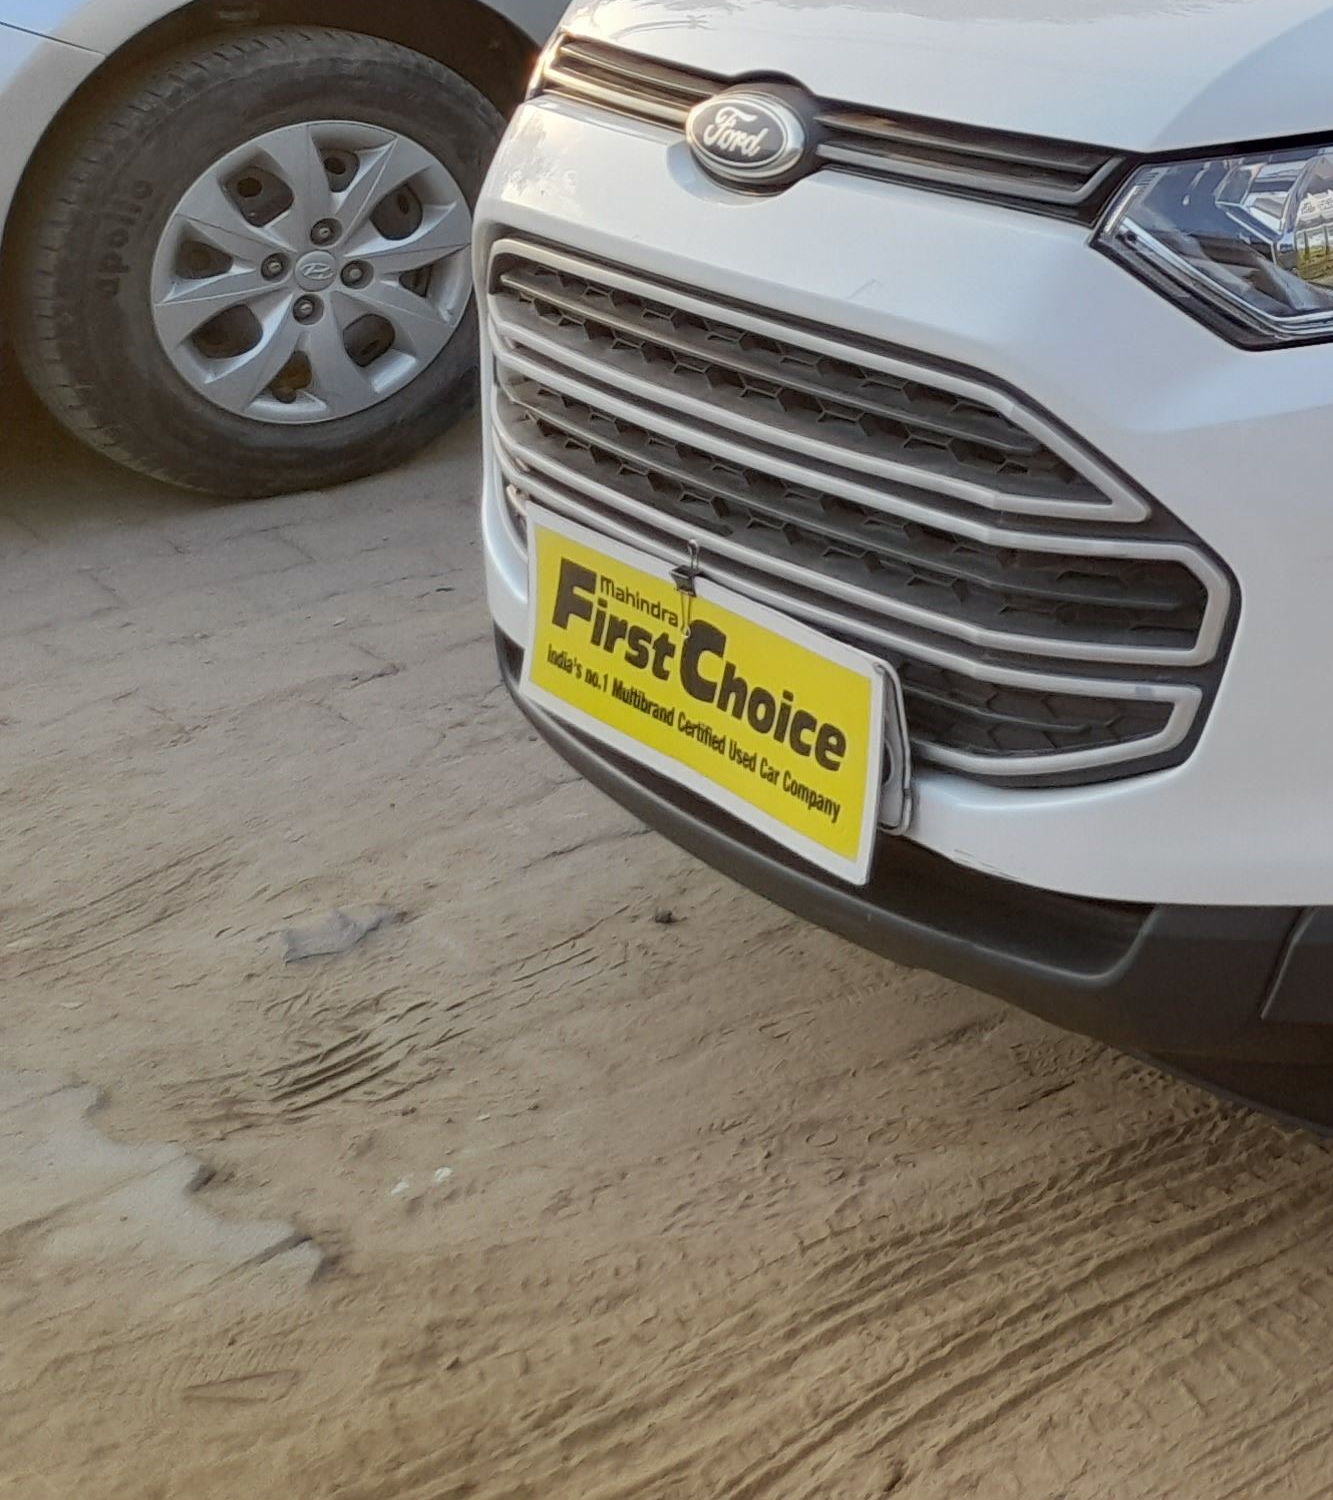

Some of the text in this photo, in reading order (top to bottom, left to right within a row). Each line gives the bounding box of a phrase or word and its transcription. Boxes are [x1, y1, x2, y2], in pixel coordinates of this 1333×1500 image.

[703, 106, 769, 158] Ford
[601, 575, 679, 628] Mahindra
[547, 644, 582, 680] India's
[611, 677, 675, 727] Multibrand
[677, 711, 726, 755] Certified
[729, 739, 757, 773] Used
[759, 757, 780, 786] Car
[783, 770, 841, 824] Company
